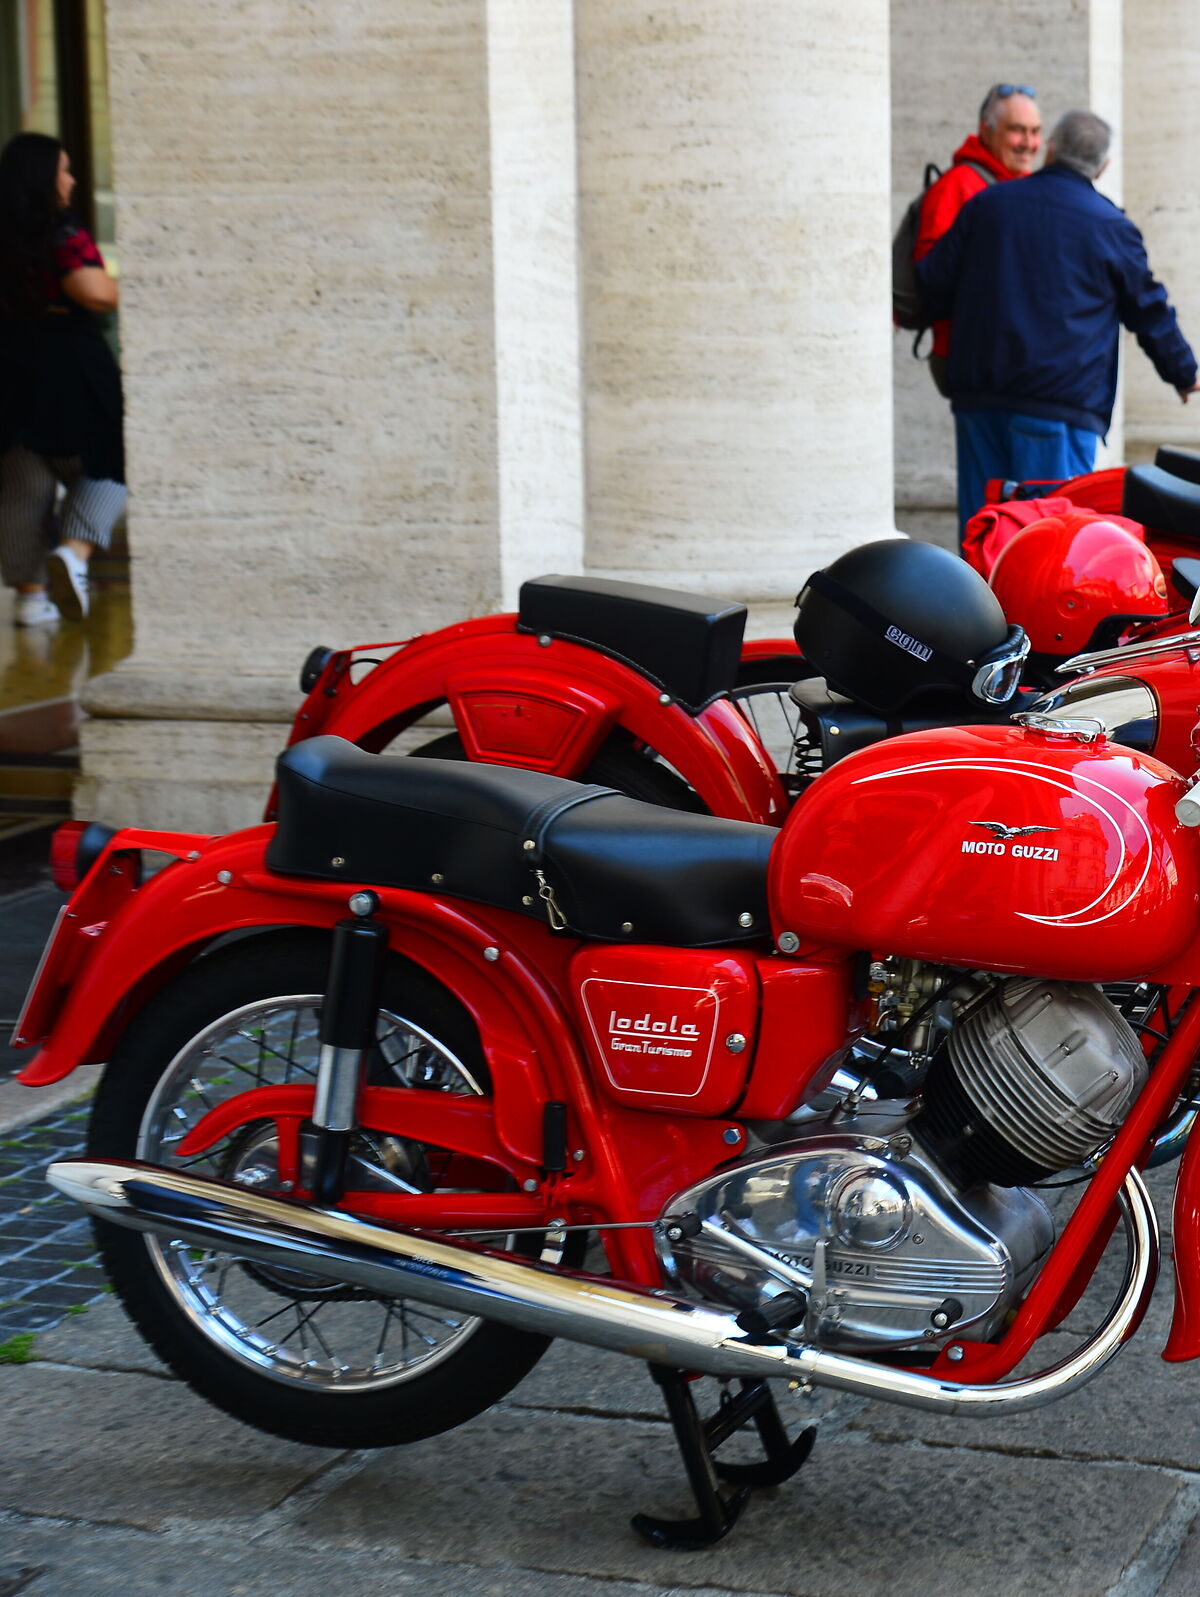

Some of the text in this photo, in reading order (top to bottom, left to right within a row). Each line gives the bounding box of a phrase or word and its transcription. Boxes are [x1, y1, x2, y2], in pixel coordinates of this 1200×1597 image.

[961, 841, 1059, 861] MOTO GUZZI
[608, 1010, 700, 1040] Lodola
[641, 1041, 693, 1058] Turismo
